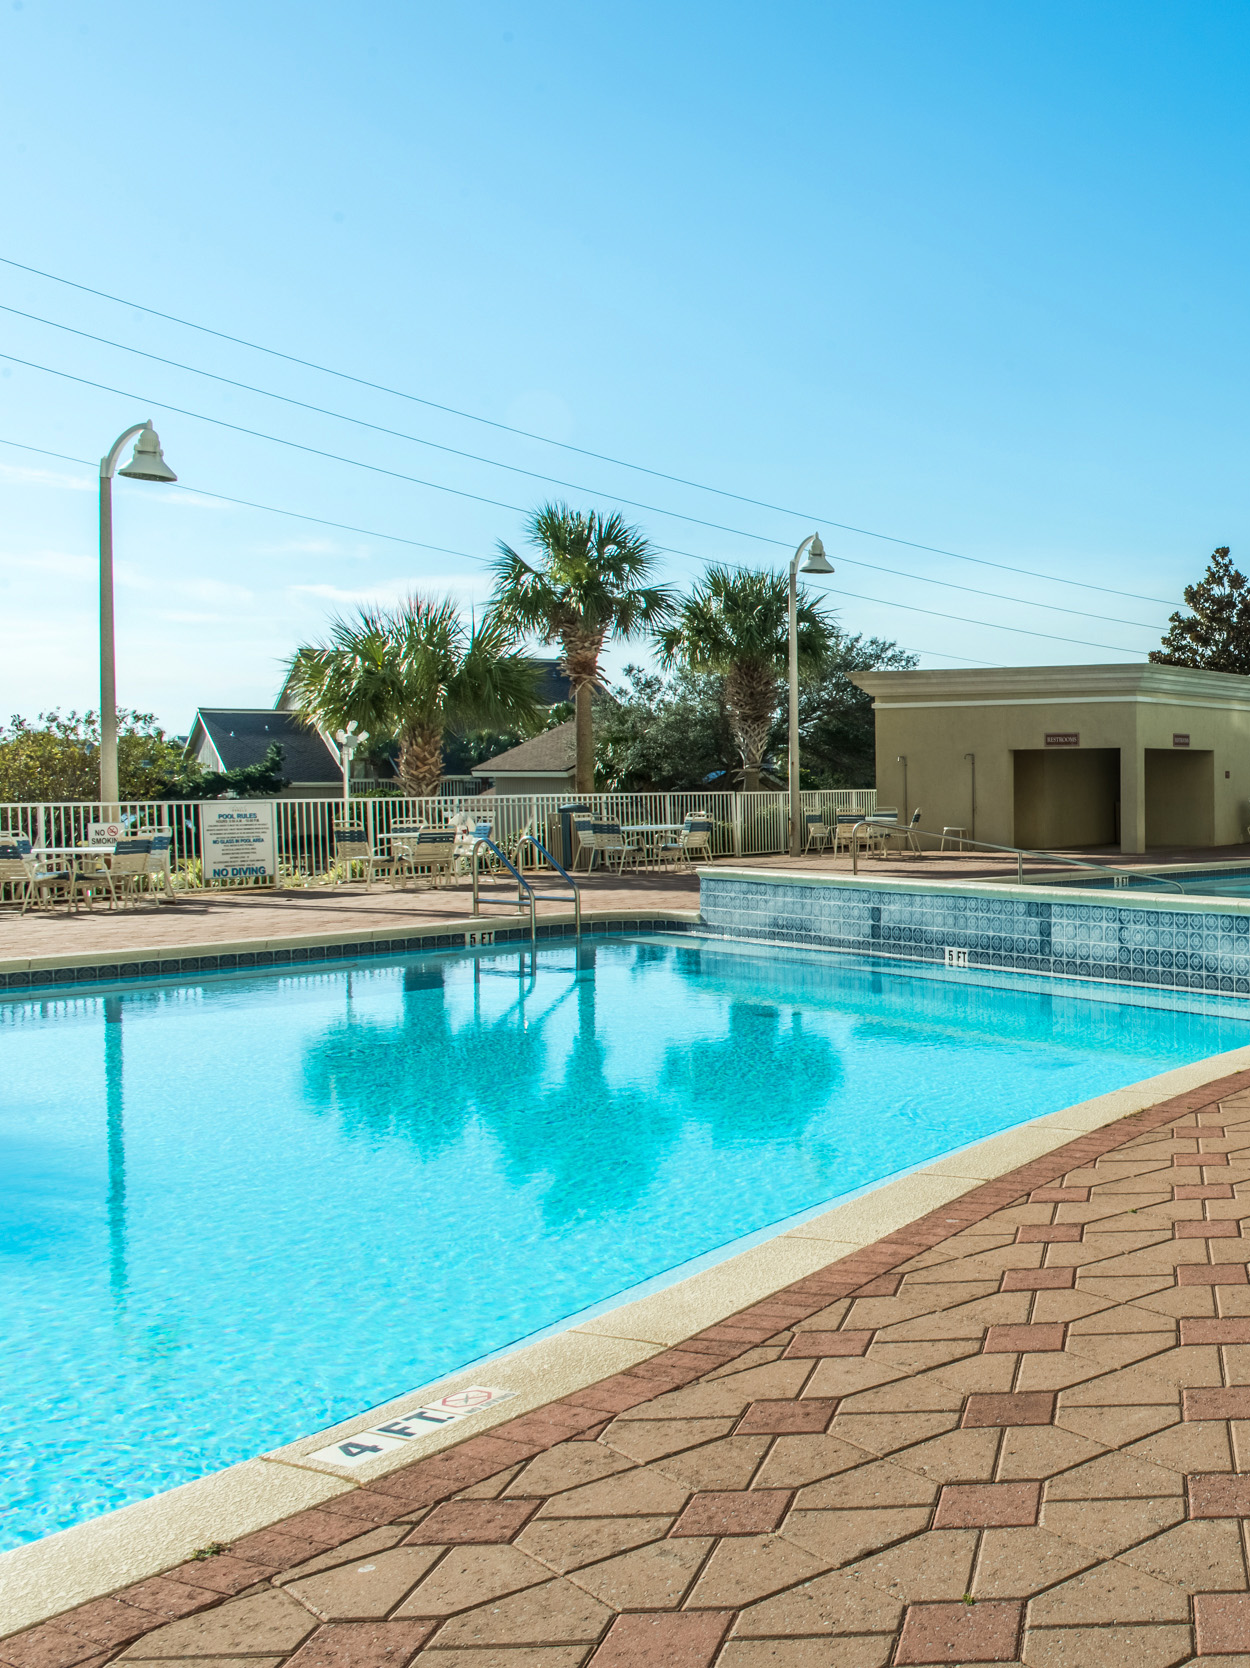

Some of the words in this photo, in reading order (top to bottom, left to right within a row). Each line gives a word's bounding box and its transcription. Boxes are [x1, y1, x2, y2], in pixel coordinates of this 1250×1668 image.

[91, 837, 119, 845] SMOKIN
[213, 868, 229, 877] NO
[231, 866, 266, 876] DIVING
[470, 933, 476, 945] 5
[481, 932, 493, 945] FT
[948, 950, 954, 962] 5
[957, 950, 967, 963] FT
[338, 1441, 384, 1458] 4
[376, 1410, 455, 1438] FT.
